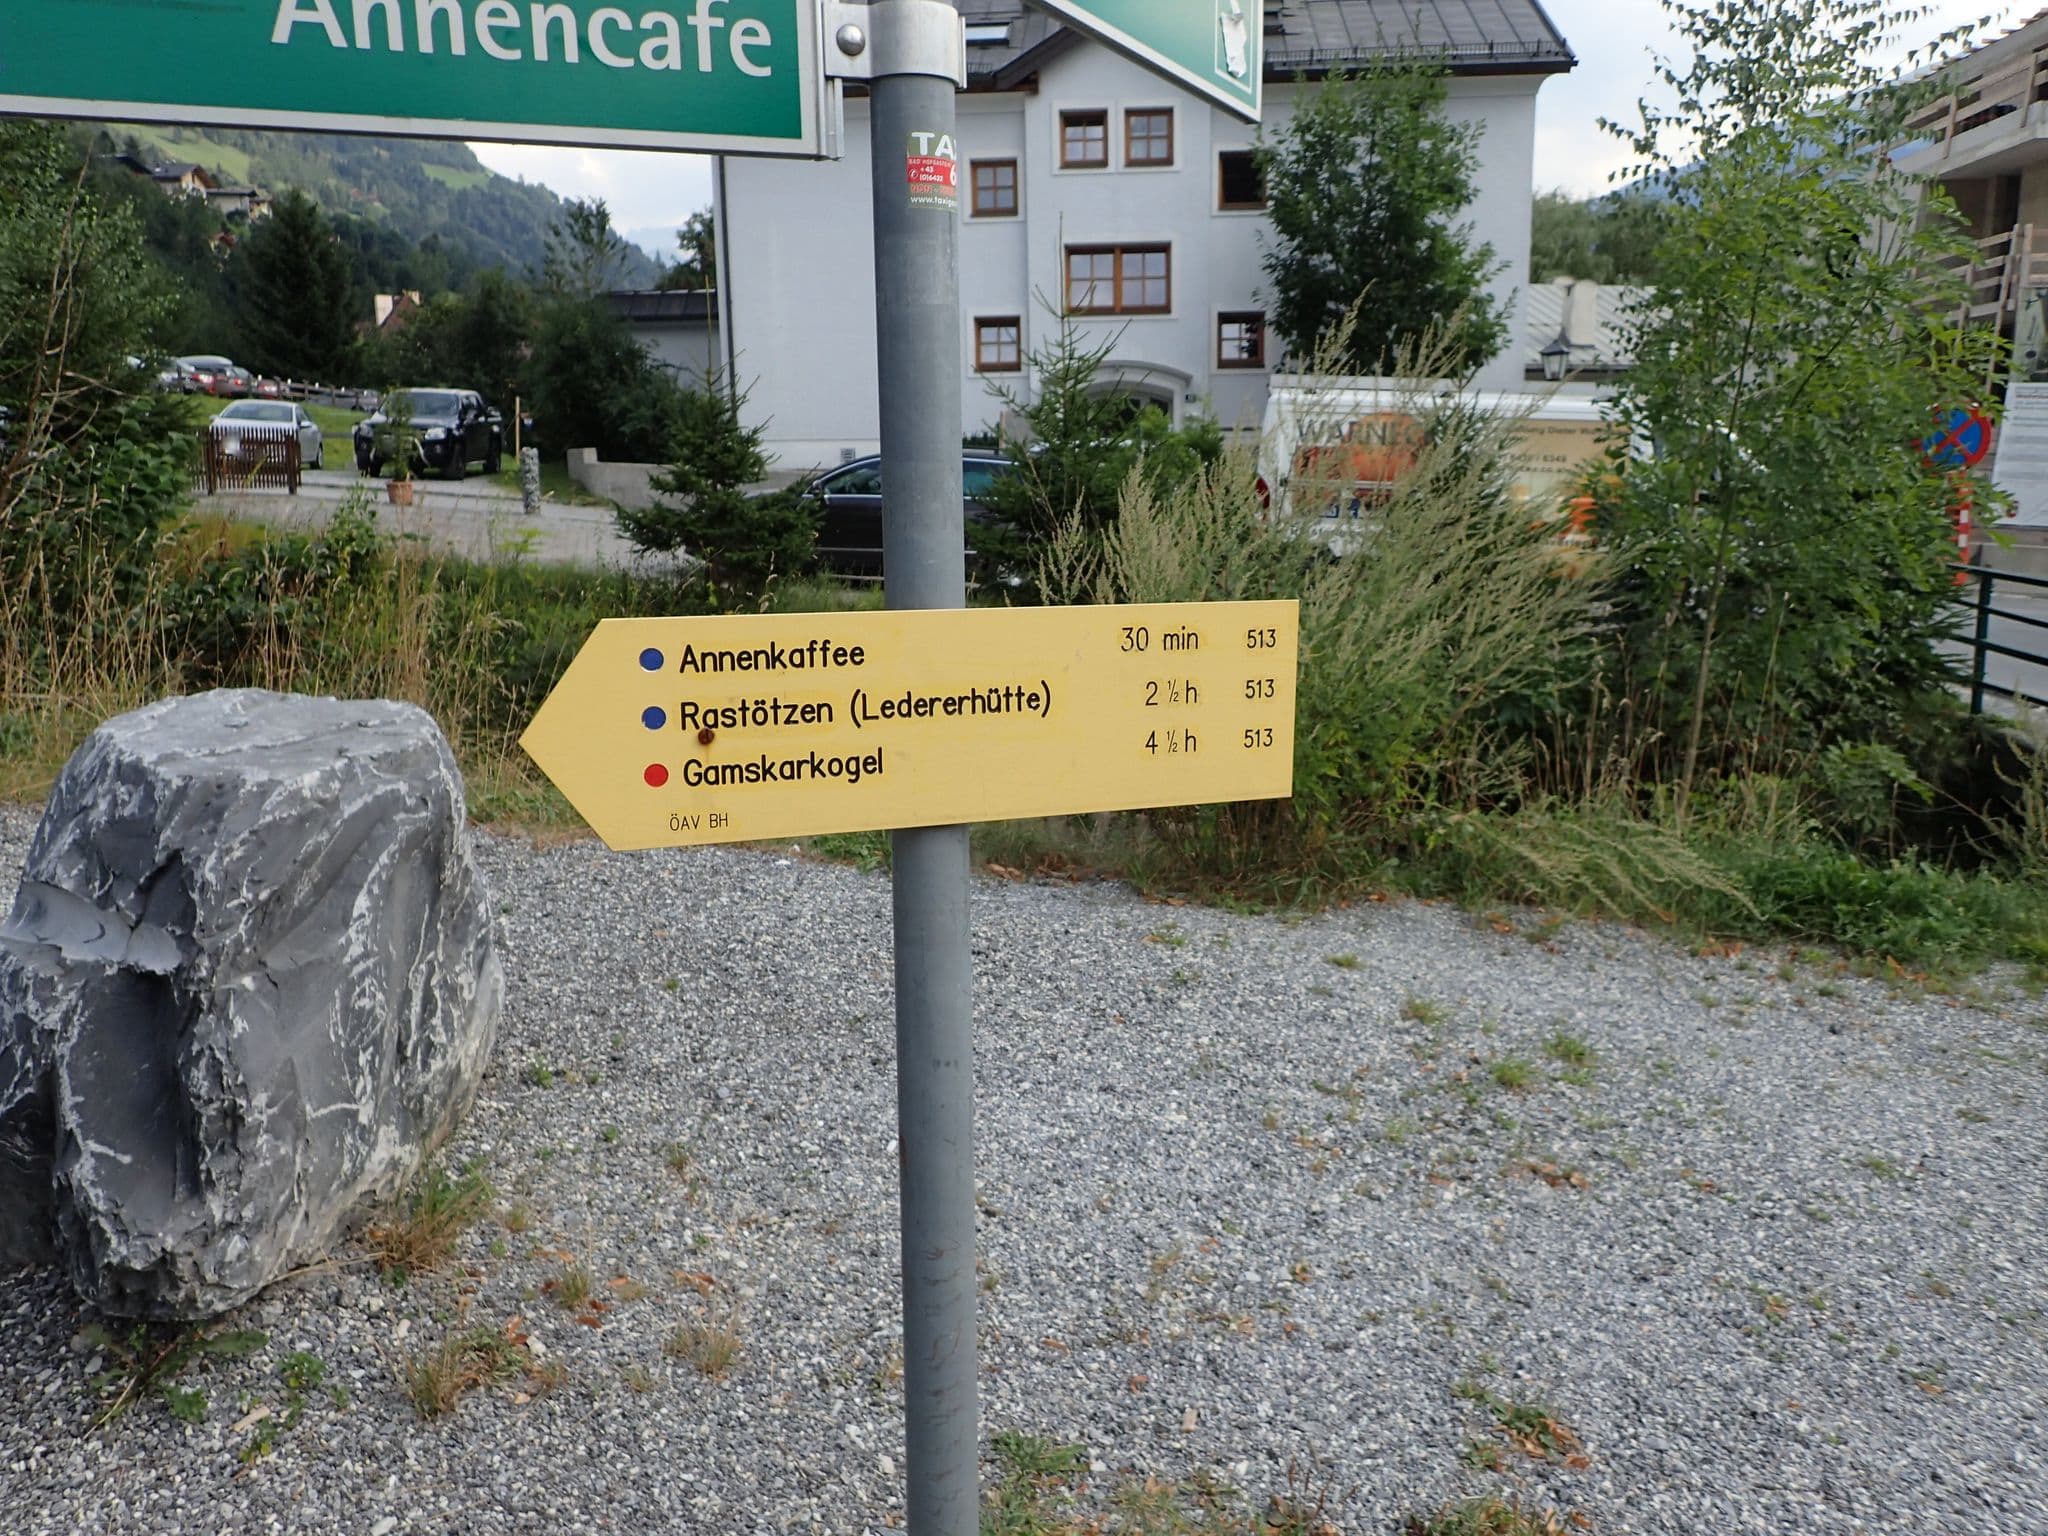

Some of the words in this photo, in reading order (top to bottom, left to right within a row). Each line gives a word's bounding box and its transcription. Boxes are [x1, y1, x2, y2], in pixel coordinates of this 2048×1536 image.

[271, 0, 771, 77] Annencafe
[911, 132, 957, 160] TA
[679, 638, 865, 674] Annenkaffee
[1120, 626, 1149, 652] 30
[1163, 625, 1199, 651] min
[1246, 628, 1277, 649] 513
[680, 697, 834, 731] Rastötzen
[850, 679, 1051, 729] (Ledererhütte)
[1145, 680, 1159, 706] 2
[1185, 679, 1198, 705] h
[1245, 678, 1275, 700] 513
[683, 746, 884, 787] Gamskarkogel
[1144, 730, 1159, 755] 4
[1184, 728, 1197, 753] h
[1243, 728, 1273, 749] 513
[669, 813, 701, 832] ÖAV
[709, 812, 729, 829] BH
